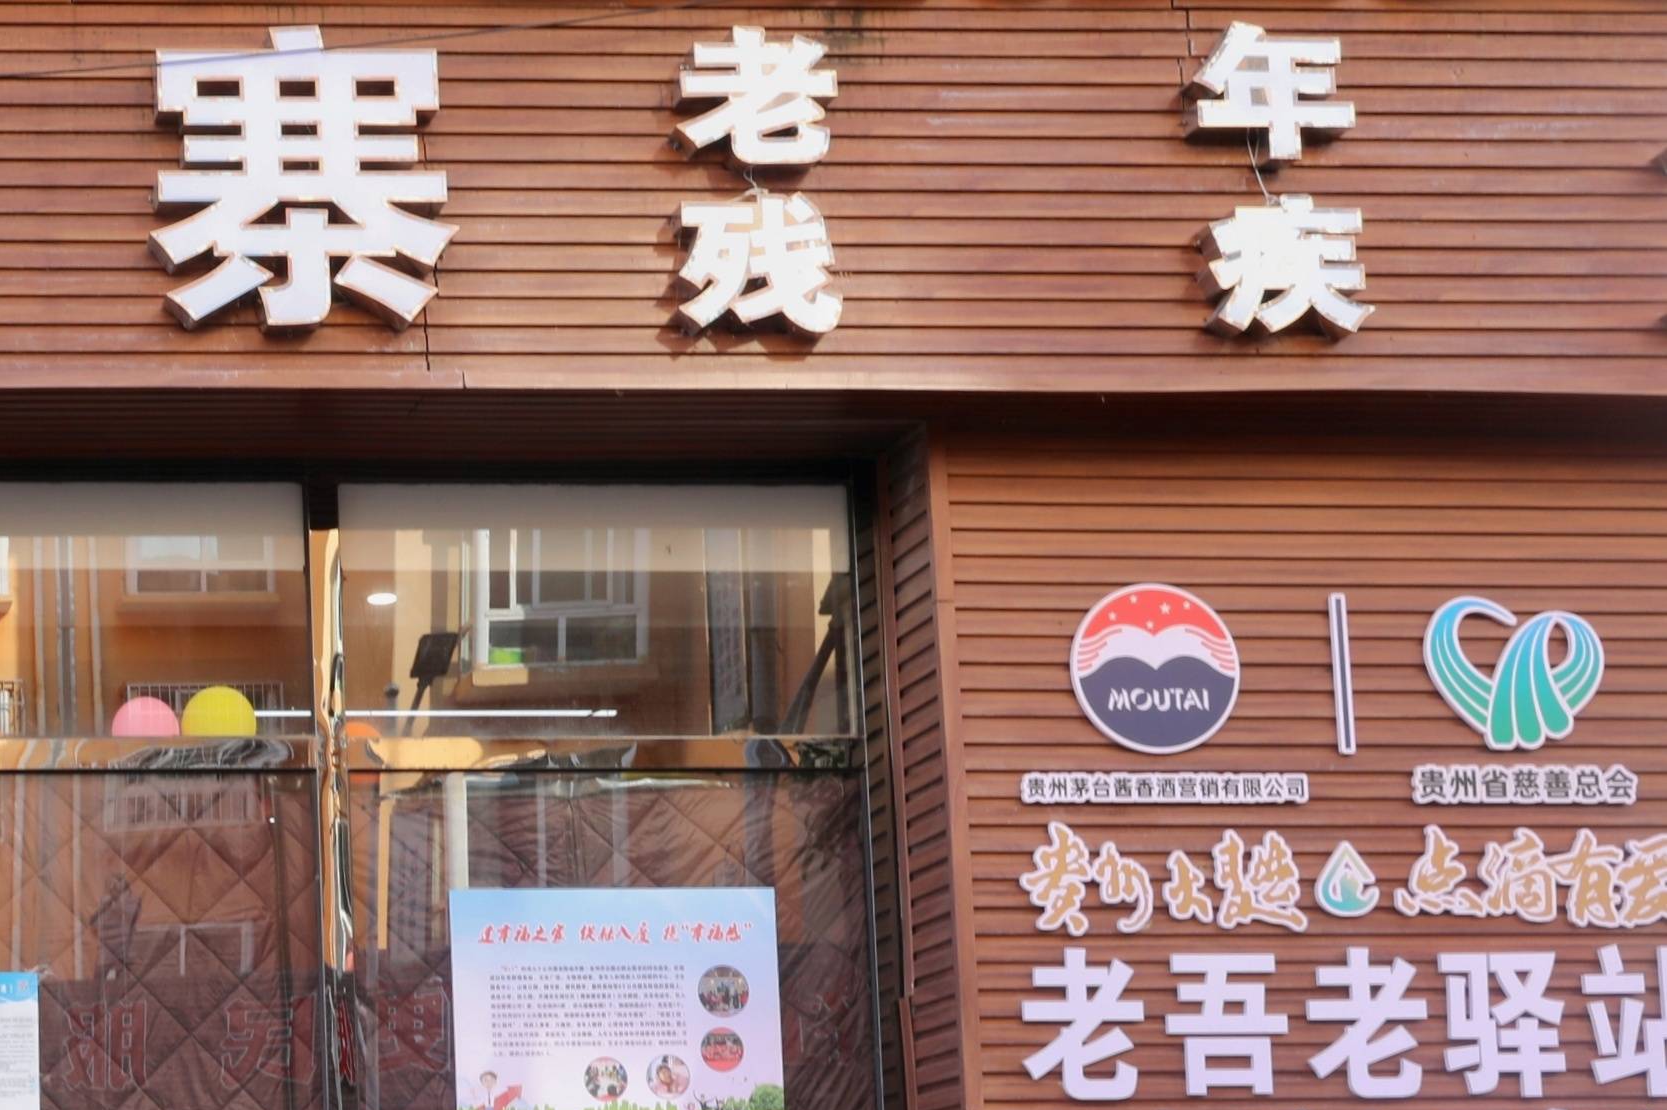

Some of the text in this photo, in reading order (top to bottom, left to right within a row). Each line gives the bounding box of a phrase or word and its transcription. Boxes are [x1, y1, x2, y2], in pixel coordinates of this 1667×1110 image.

[1107, 686, 1211, 713] MOUTAI
[1025, 775, 1308, 801] 贵州茅台酱香酒营销有限公司
[1418, 767, 1635, 800] 贵州省慈善总会
[1022, 945, 1667, 1101] 老吾老驿站
